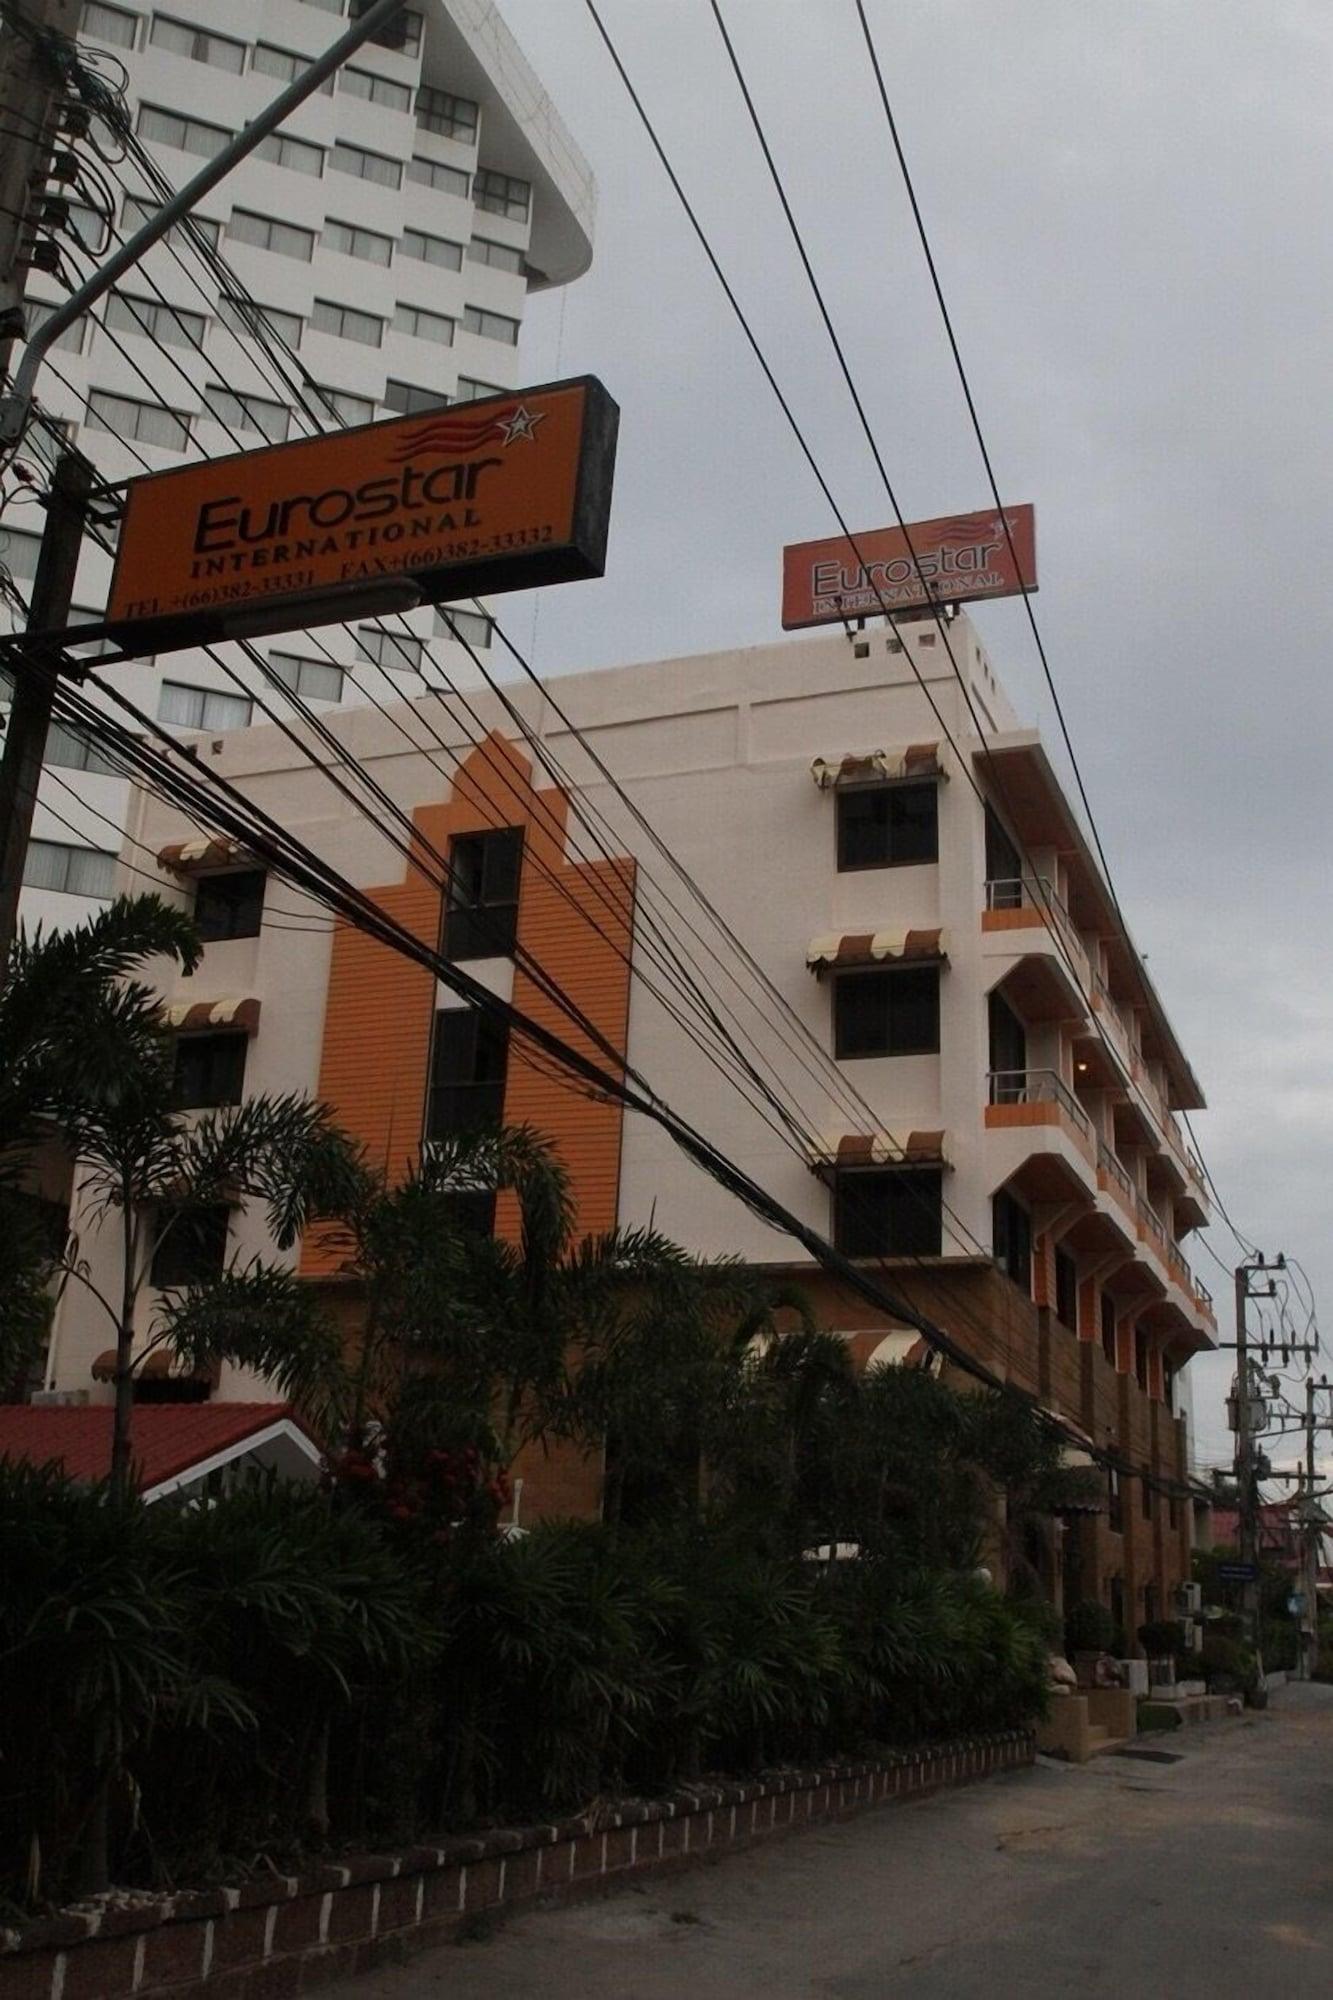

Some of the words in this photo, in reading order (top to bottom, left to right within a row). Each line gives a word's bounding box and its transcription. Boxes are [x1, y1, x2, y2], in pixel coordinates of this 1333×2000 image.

[195, 458, 502, 553] Eurostar
[190, 510, 482, 579] INTERNATIONAL
[813, 543, 1003, 597] Eurostar
